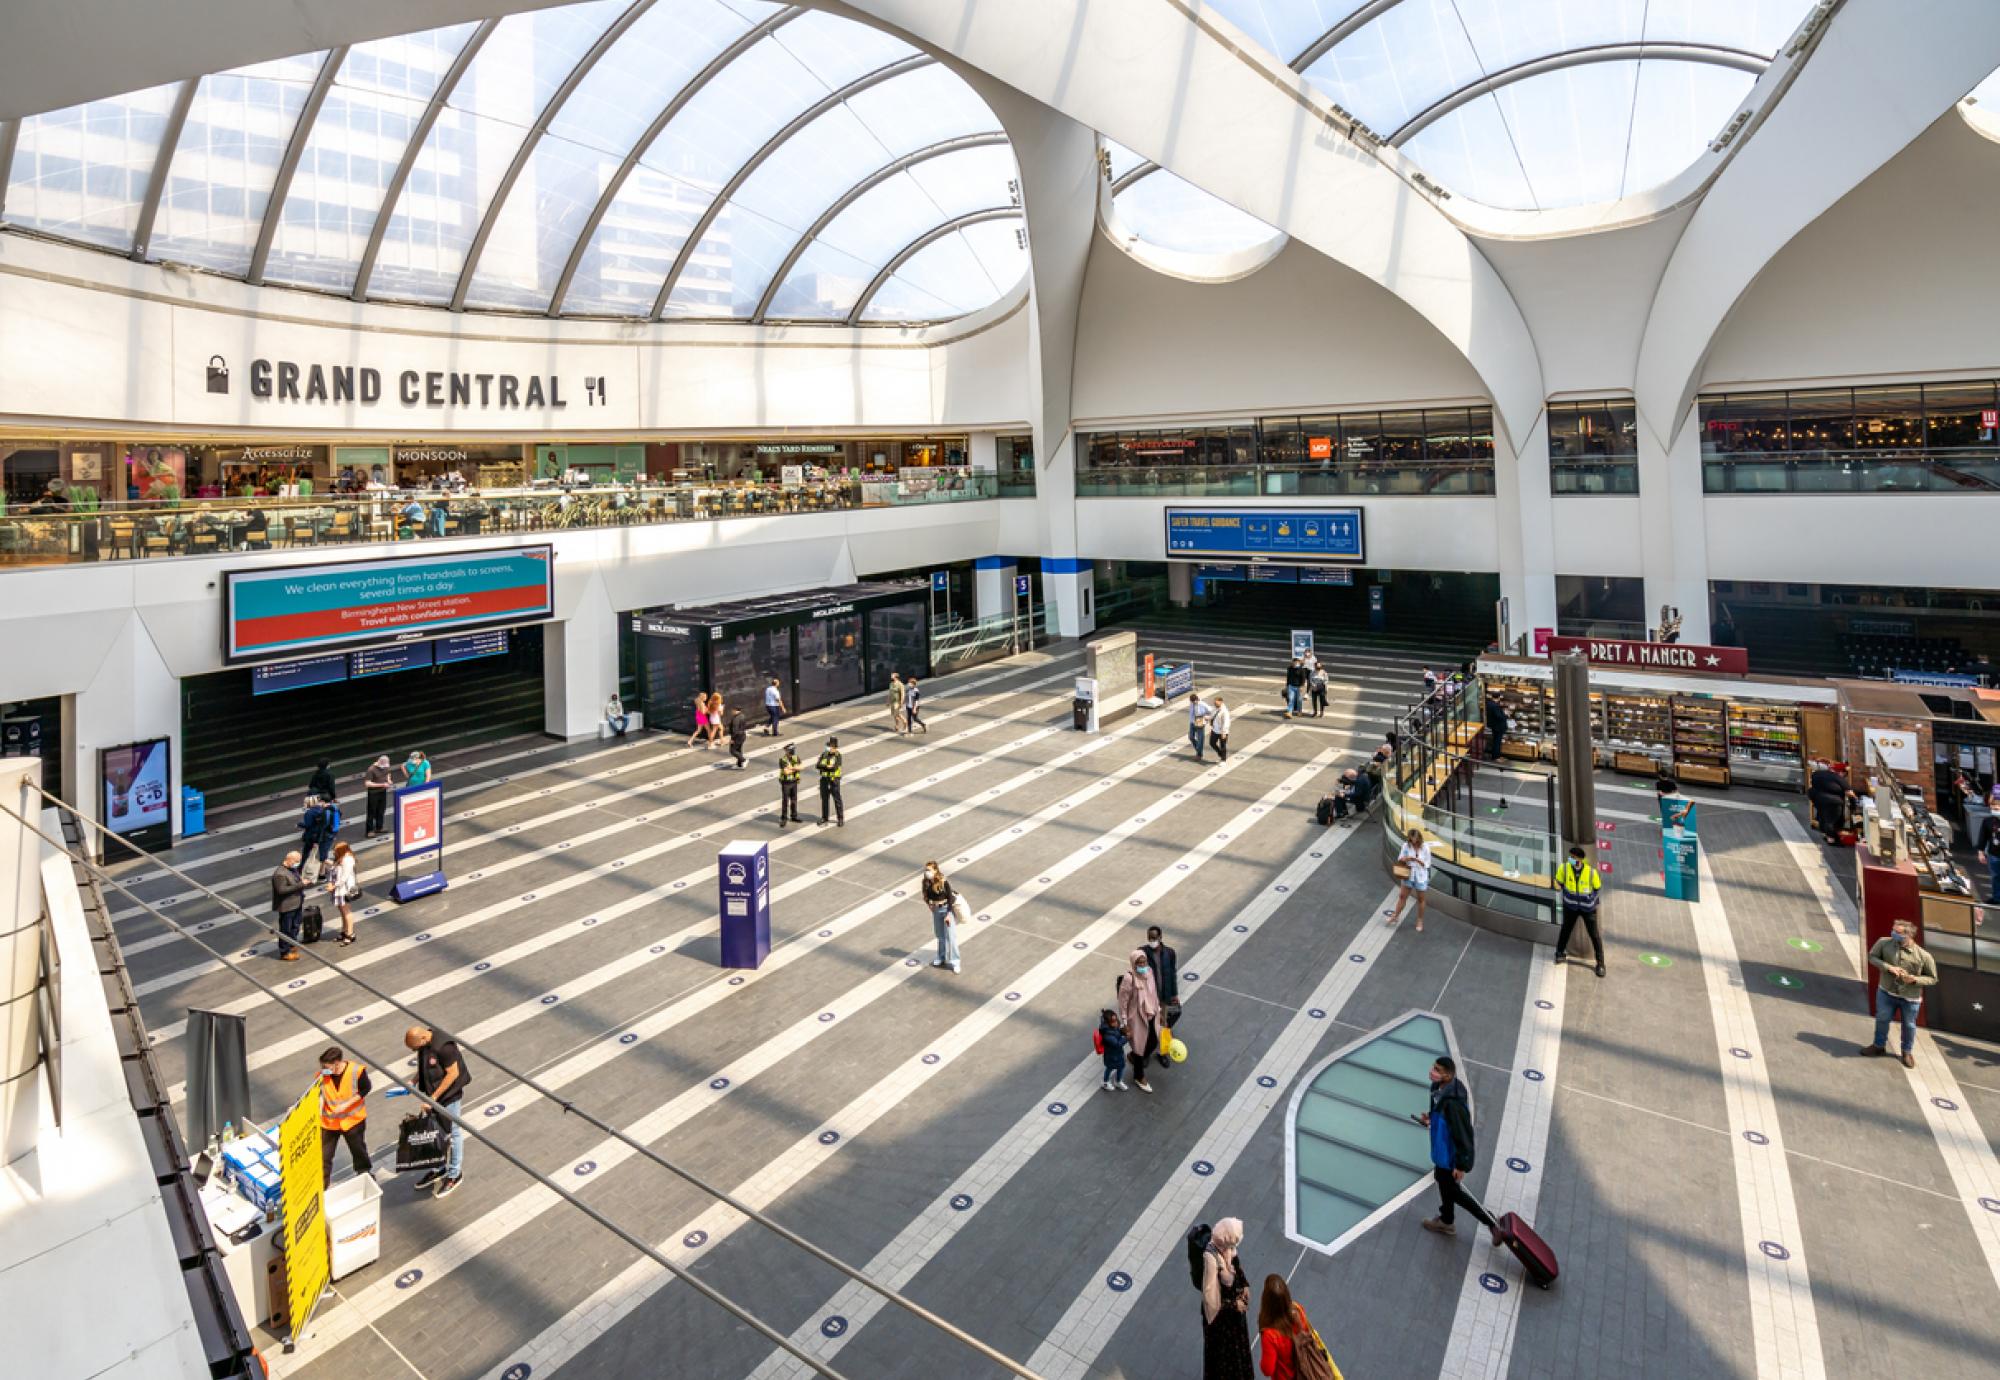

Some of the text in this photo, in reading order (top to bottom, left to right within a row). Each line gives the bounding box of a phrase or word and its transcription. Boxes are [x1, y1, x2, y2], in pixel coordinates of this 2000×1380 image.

[250, 359, 567, 407] GRAND CENTRAL
[242, 447, 313, 460] Accessorize
[397, 450, 468, 461] MONSOON
[802, 445, 836, 453] REMEDIES
[1211, 517, 1241, 528] GUIDANCE
[285, 564, 514, 595] We clean everything from handrails to screens,
[938, 575, 944, 585] 4
[1020, 580, 1027, 590] 5
[360, 581, 455, 600] several times a day.
[341, 605, 394, 620] Birmingham
[396, 603, 415, 612] New
[417, 600, 441, 610] Street
[360, 607, 456, 627] Travel with confidence
[1590, 643, 1696, 667] PRET A MANGER
[290, 1125, 318, 1168] FREE?
